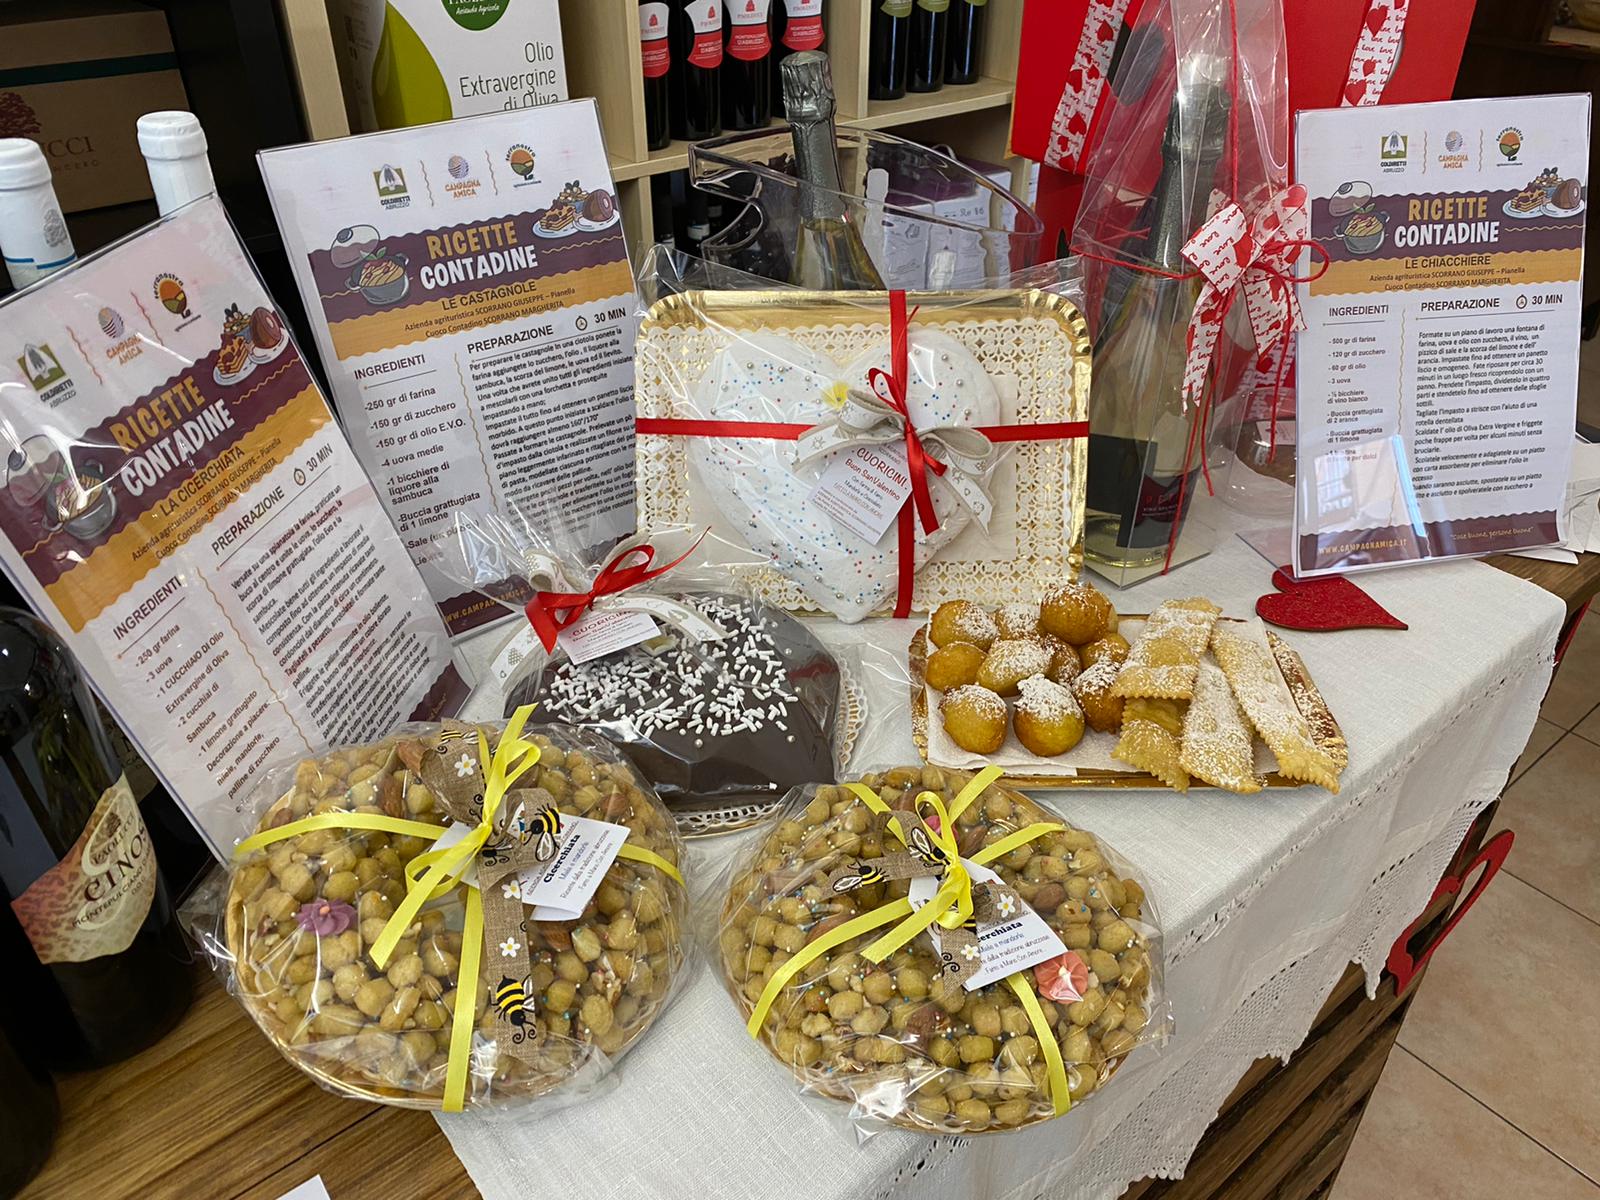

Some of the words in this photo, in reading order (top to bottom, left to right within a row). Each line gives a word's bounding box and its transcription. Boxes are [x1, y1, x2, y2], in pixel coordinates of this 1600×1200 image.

[524, 41, 554, 63] Olio
[459, 68, 556, 97] Extravergine
[451, 187, 476, 199] AMICA
[1408, 196, 1487, 220] RICETTE
[424, 220, 518, 259] RICETTE
[1394, 221, 1499, 248] CONTADINE
[417, 244, 539, 290] CONTADINE
[1394, 272, 1431, 282] agrituristica
[1431, 270, 1465, 279] SCORRANO
[1405, 259, 1419, 269] LE
[1419, 255, 1490, 268] CHIACCHIERE
[404, 319, 433, 331] Azienda
[433, 309, 475, 326] agrituristica
[474, 300, 514, 317] SCORRANO
[511, 293, 545, 308] GIUSEPPE
[549, 286, 575, 299] Pianella
[441, 297, 459, 310] LE
[458, 280, 537, 307] CASTAGNOLE
[1329, 304, 1388, 316] INGREDIENTI
[1421, 298, 1499, 312] PREPARAZIONE
[1531, 295, 1542, 304] 30
[1545, 294, 1562, 304] MIN
[424, 326, 448, 338] Cuoco
[446, 318, 483, 333] Contadino
[482, 309, 521, 325] SCORRANO
[519, 299, 564, 316] MARGHERITA
[593, 312, 606, 323] 30
[607, 307, 626, 320] MIN
[115, 343, 143, 365] AMICA
[466, 324, 553, 354] PREPARAZIONE
[469, 362, 482, 371] Per
[481, 355, 514, 369] preparare
[513, 352, 521, 360] le
[520, 344, 554, 360] castagnole
[561, 340, 574, 348] una
[573, 334, 594, 345] ciotola
[594, 329, 616, 340] ponete
[353, 353, 425, 379] INGREDIENTI
[363, 399, 385, 411] -250
[385, 397, 398, 407] gr
[397, 393, 408, 403] di
[408, 386, 436, 400] farina
[107, 375, 206, 456] RICETTE
[369, 418, 390, 431] -150
[390, 416, 403, 426] gr
[402, 412, 414, 422] di
[413, 400, 456, 419] zucchero
[374, 437, 396, 449] -150
[396, 434, 409, 445] gr
[407, 430, 419, 440] di
[418, 425, 438, 437] olio
[438, 417, 466, 432] E.V.O.
[117, 397, 236, 500] CONTADINE
[305, 455, 318, 472] 30
[315, 442, 333, 463] MIN
[391, 452, 415, 465] uova
[415, 443, 444, 458] medie
[159, 495, 180, 517] LA
[175, 444, 244, 504] CICERCHIATA
[396, 464, 440, 484] bicchiere
[439, 461, 450, 471] di
[845, 458, 861, 474] Buon
[856, 447, 908, 488] CUORICINI
[130, 533, 162, 564] Azienda
[156, 503, 199, 543] agrituristica
[194, 477, 231, 512] SCORRANO
[227, 455, 258, 484] GIUSEPPE
[258, 435, 282, 459] Pianella
[388, 480, 422, 497] liquore
[421, 474, 439, 486] alla
[391, 486, 433, 505] sambuca
[210, 484, 285, 556] PREPARAZIONE
[396, 505, 433, 524] -Buccia
[432, 490, 480, 513] grattugiata
[398, 522, 409, 532] di
[417, 510, 448, 526] limone
[112, 575, 182, 640] INGREDIENTI
[137, 648, 153, 665] 250
[151, 640, 163, 654] gr
[159, 623, 180, 645] farina
[164, 649, 203, 690] CUCCHIAIO
[200, 641, 211, 654] DI
[208, 628, 224, 647] Olio
[148, 670, 156, 680] 3
[154, 655, 173, 675] uova
[165, 669, 207, 716] Extravergine
[203, 662, 213, 675] di
[210, 647, 229, 668] Oliva
[179, 715, 187, 725] 2
[184, 688, 213, 720] cucchiai
[210, 681, 219, 693] di
[185, 708, 217, 744] Sambuca
[204, 721, 228, 749] limone
[225, 688, 258, 727] grattugiato
[206, 727, 244, 773] Decorazione
[242, 723, 248, 732] a
[227, 771, 250, 799] palline
[246, 763, 256, 775] di
[253, 734, 280, 768] zucchero
[543, 834, 581, 883] Cicerchiata
